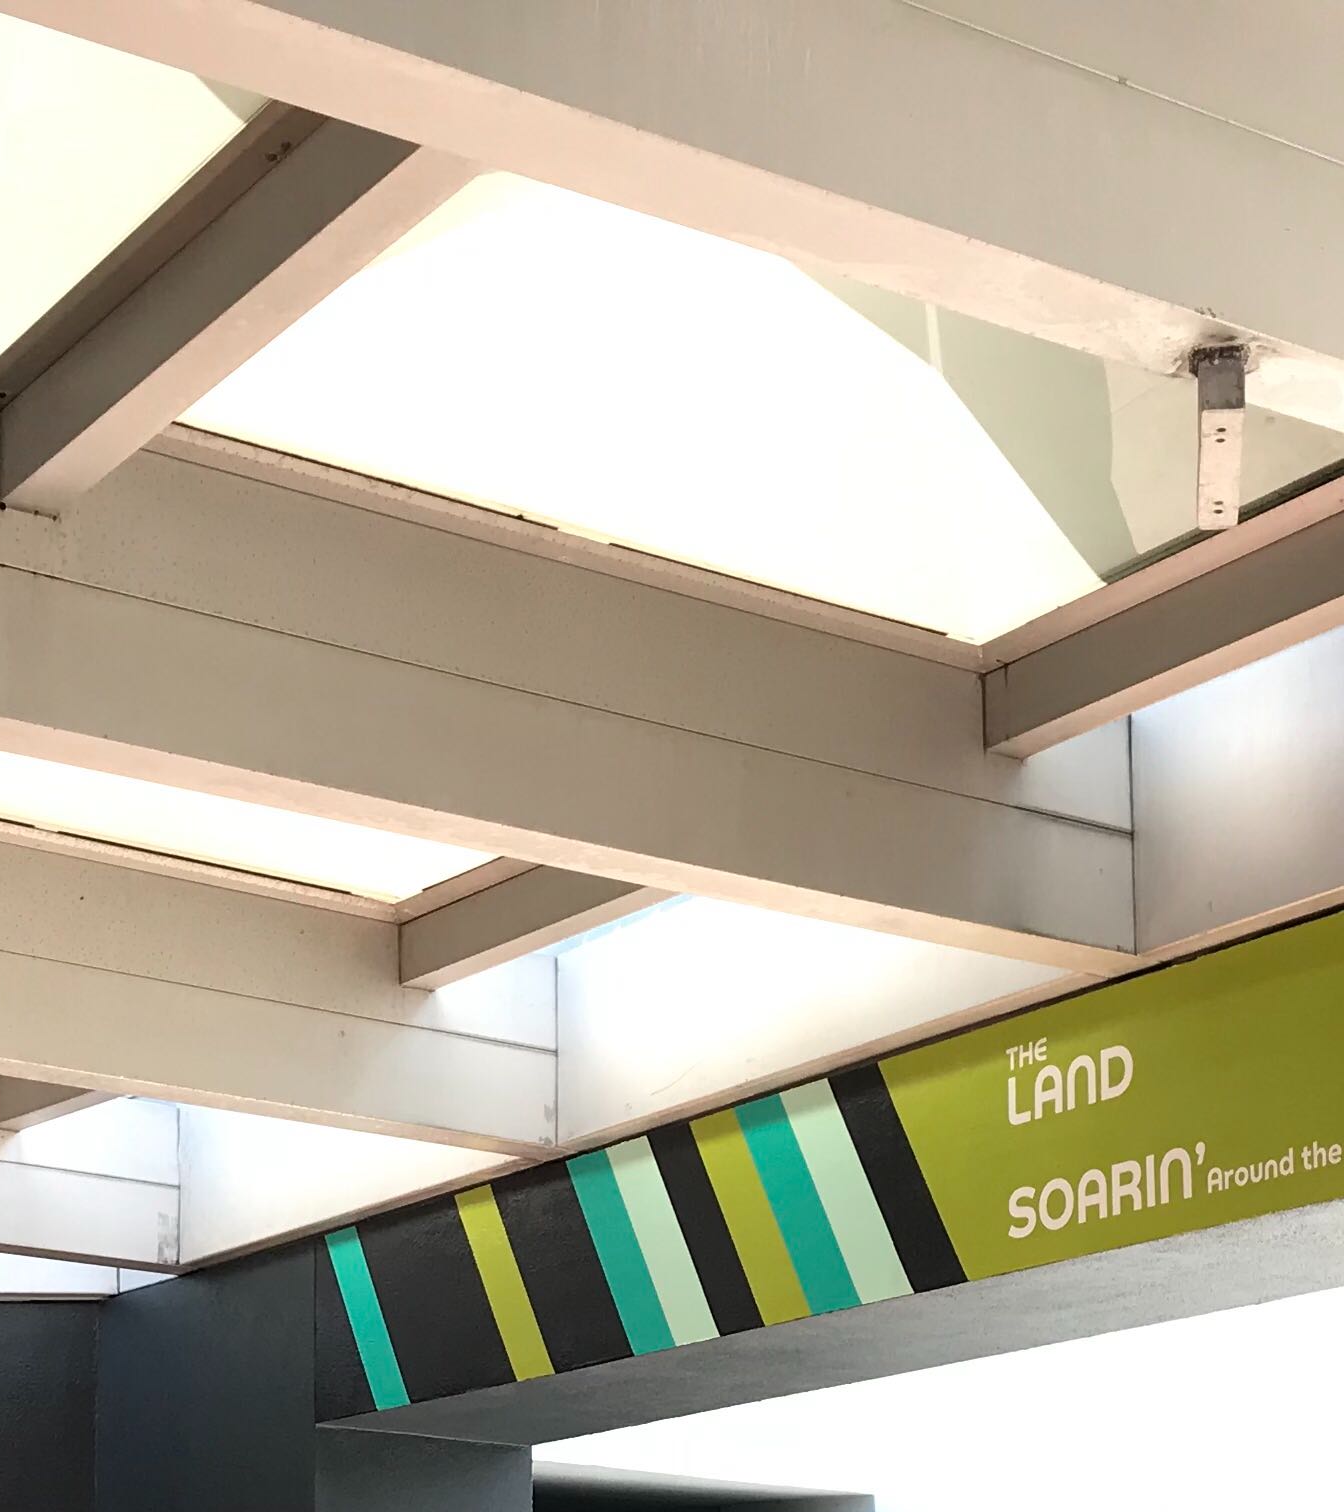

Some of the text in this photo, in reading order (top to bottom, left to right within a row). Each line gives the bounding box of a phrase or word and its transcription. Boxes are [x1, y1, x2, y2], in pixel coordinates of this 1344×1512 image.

[1005, 1037, 1048, 1072] THE
[1007, 1044, 1134, 1126] LAND
[1207, 1147, 1295, 1194] Around
[1301, 1141, 1342, 1171] the
